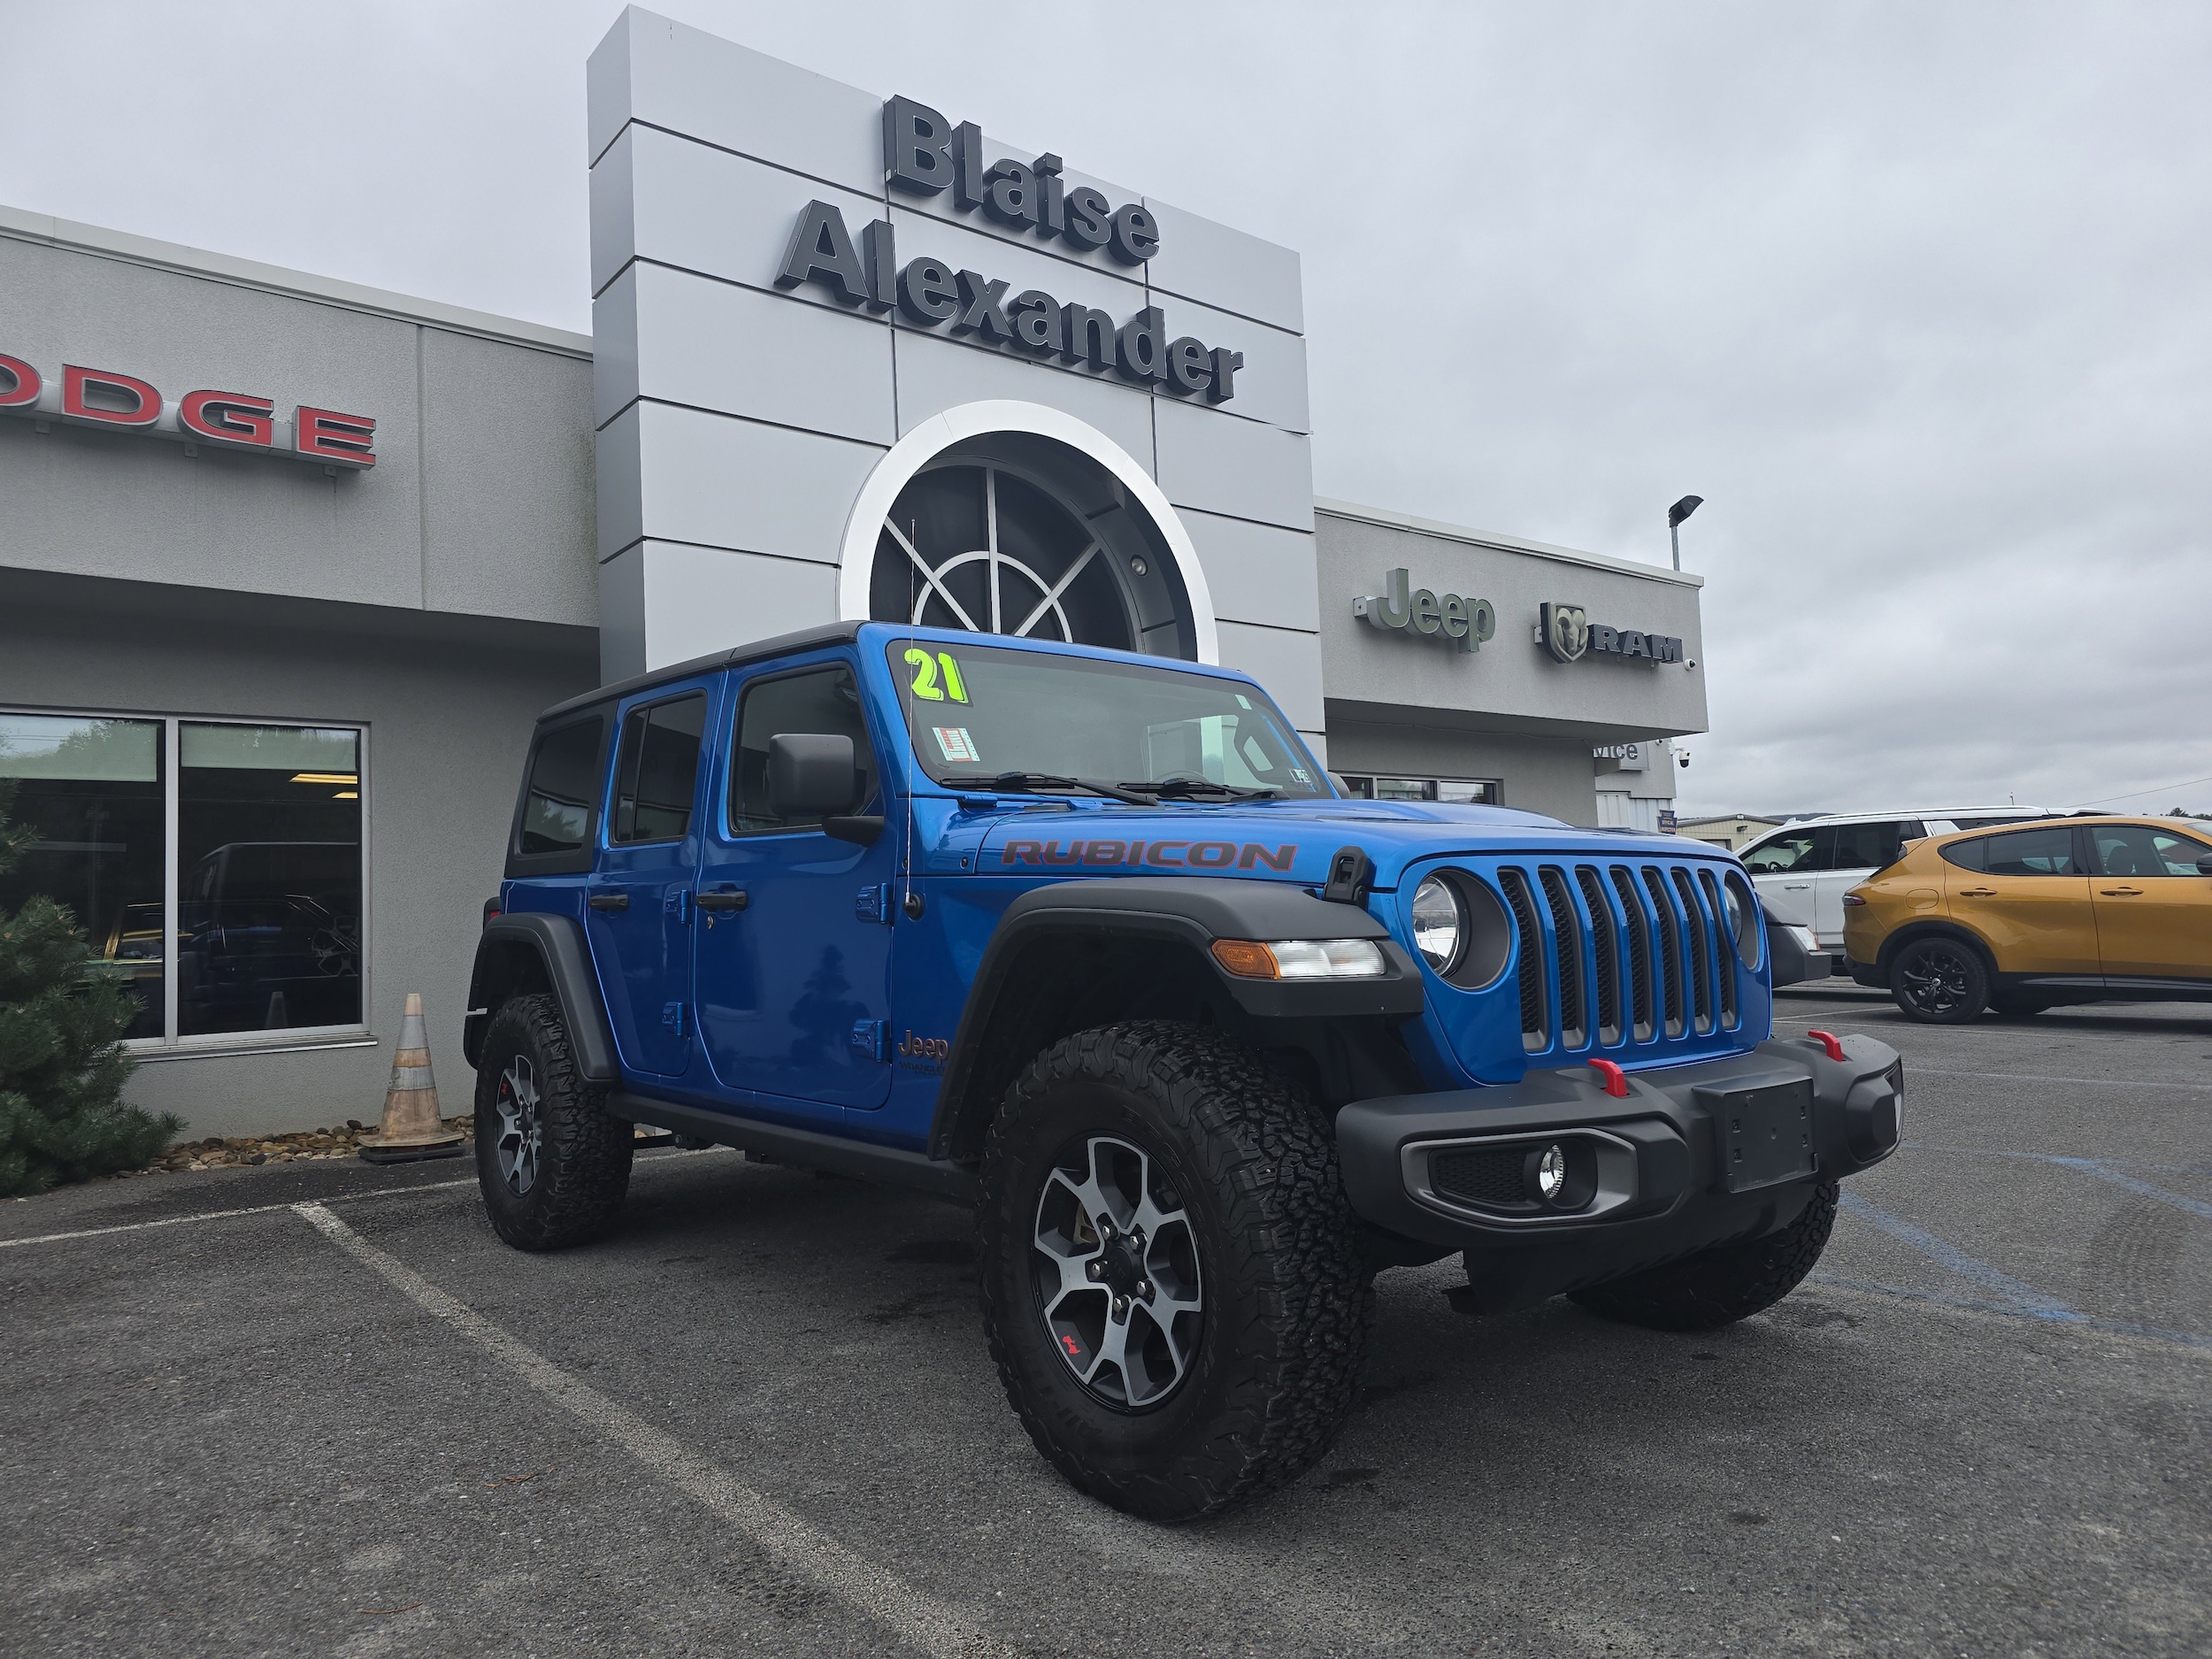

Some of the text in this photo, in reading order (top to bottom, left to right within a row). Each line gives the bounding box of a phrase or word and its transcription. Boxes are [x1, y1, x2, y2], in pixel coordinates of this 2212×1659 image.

[885, 95, 1160, 266] Blaise
[774, 199, 1244, 403] Alexander
[1367, 568, 1495, 653] Jeep
[1588, 623, 1683, 664] RAM
[904, 648, 969, 703] 21
[1002, 840, 1299, 872] RUBICON
[898, 1029, 949, 1065] Jeep
